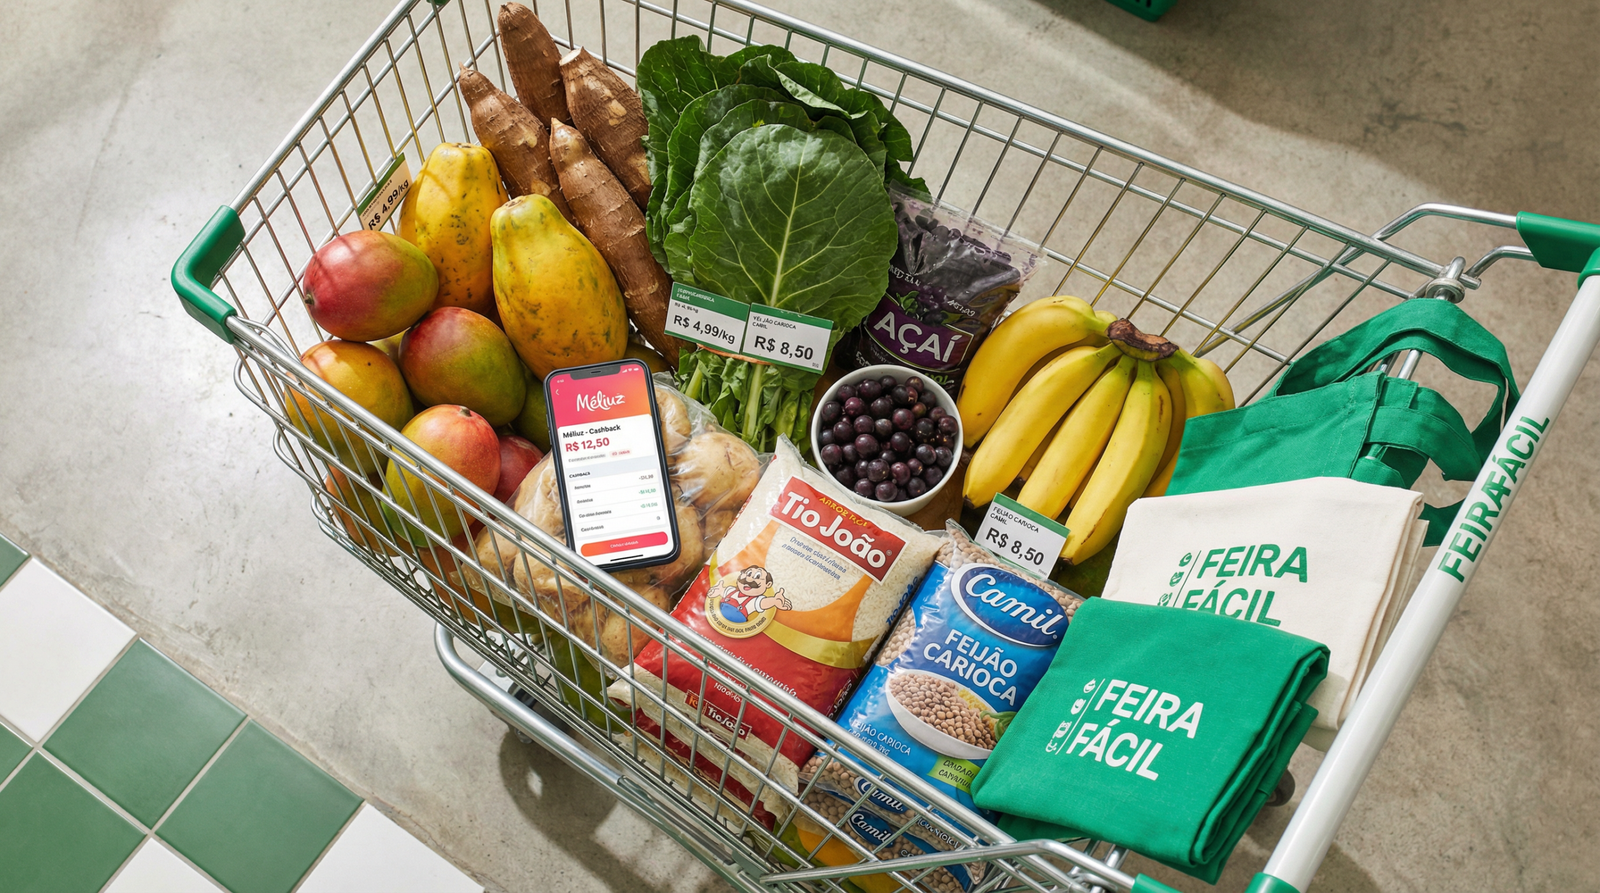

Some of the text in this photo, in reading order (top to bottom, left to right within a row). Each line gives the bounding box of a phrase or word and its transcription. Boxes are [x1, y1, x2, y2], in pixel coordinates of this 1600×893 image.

[368, 212, 381, 230] R$
[382, 180, 409, 214] 4,99/kg
[674, 314, 735, 344] R$ 4,99/kg
[754, 335, 813, 360] R$ 8,50
[873, 311, 962, 363] AÇAÍ
[576, 390, 625, 412] Méliuz
[562, 430, 584, 439] Méliuz
[589, 424, 621, 435] Cashback
[565, 437, 610, 452] R$ 12,50
[986, 527, 1044, 565] R$ 8,50
[1196, 544, 1307, 583] FEIRA
[965, 573, 1064, 635] Camil
[1182, 579, 1282, 627] FÁCIL
[923, 643, 1016, 706] CARIOCA
[944, 629, 1018, 678] FEIJÃO
[1094, 679, 1204, 739] FEIRA
[1065, 718, 1163, 781] FÁCIL
